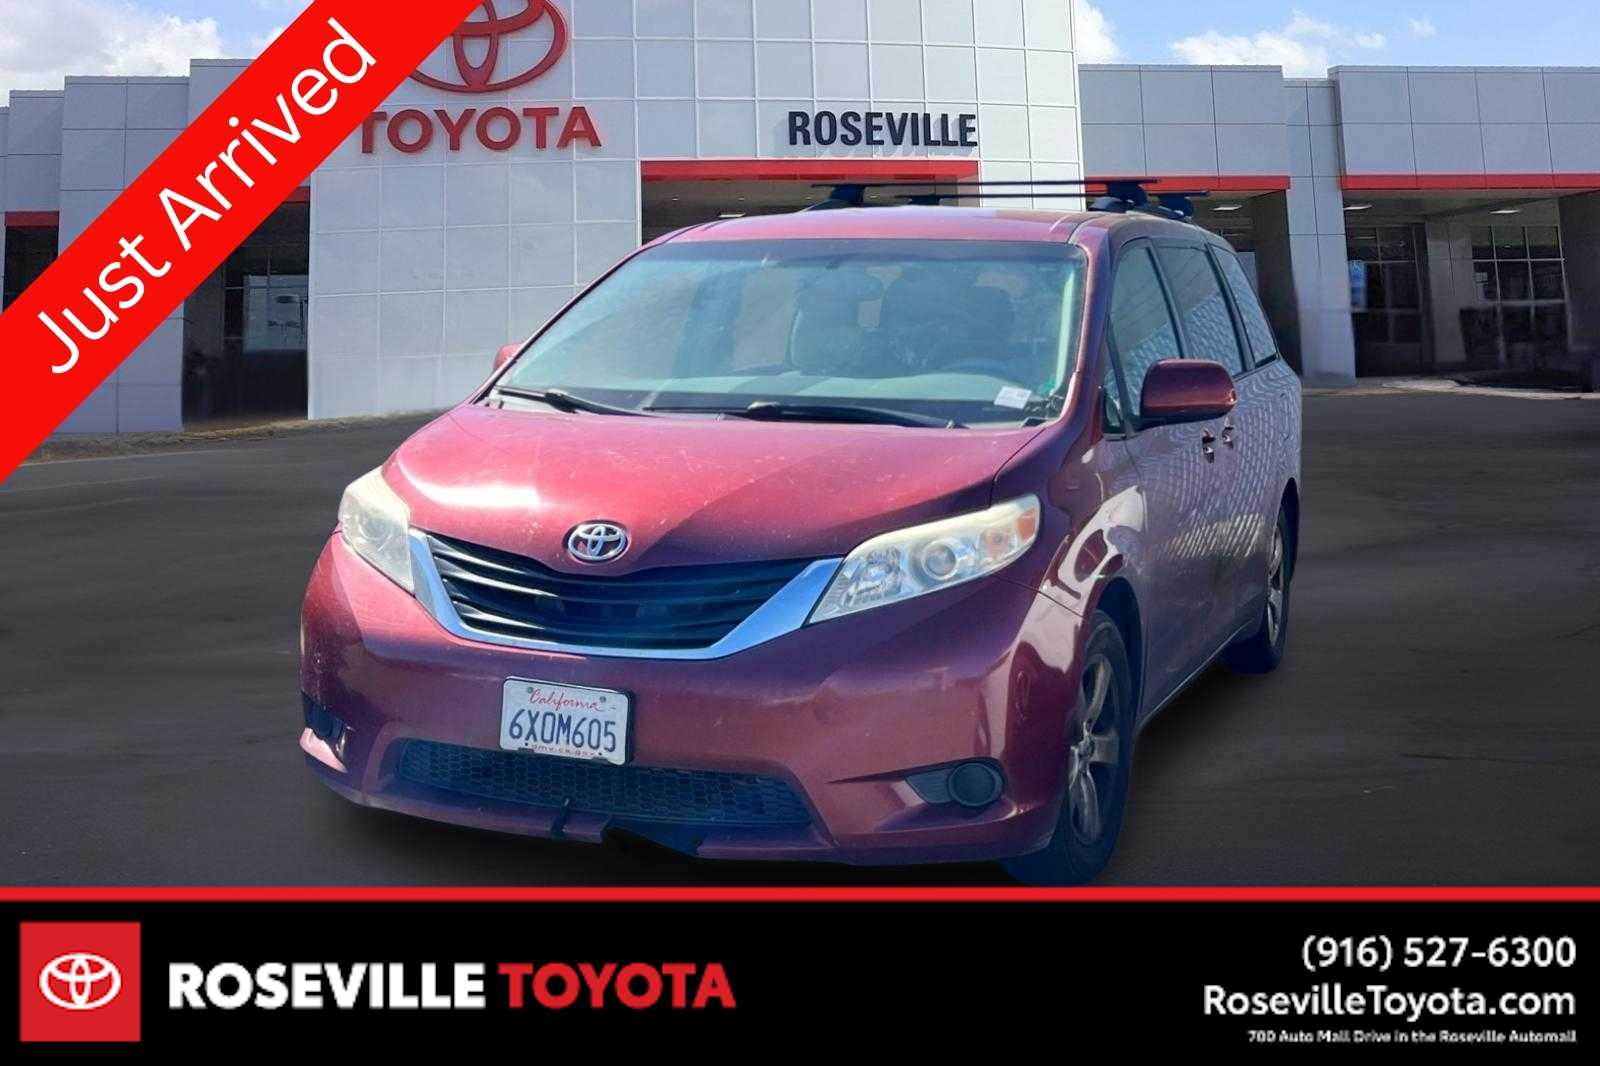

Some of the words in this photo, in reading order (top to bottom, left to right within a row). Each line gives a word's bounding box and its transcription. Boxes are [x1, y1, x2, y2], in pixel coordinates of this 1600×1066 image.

[361, 106, 602, 154] TOYOTA
[788, 110, 978, 147] ROSEVILLE
[528, 687, 604, 712] California
